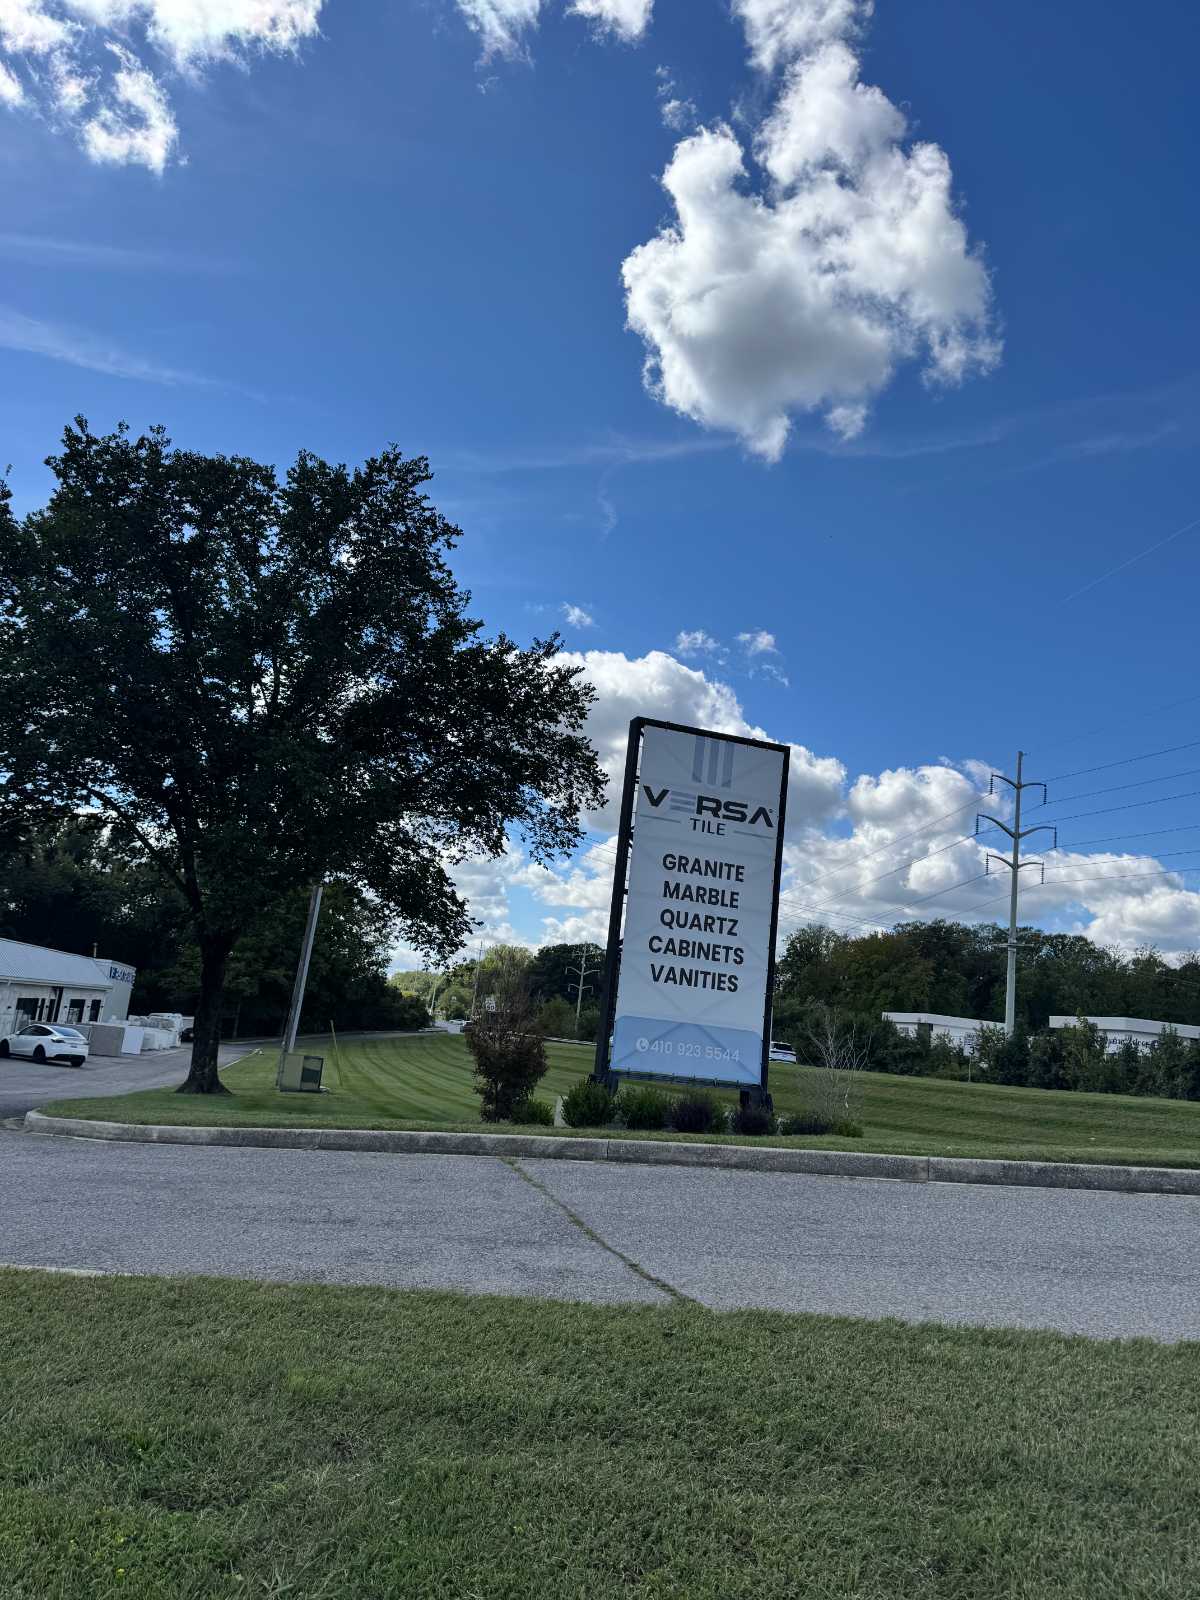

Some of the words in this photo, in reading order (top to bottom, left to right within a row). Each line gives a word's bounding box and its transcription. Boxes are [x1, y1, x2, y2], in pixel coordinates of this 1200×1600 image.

[643, 785, 773, 827] VERSA
[690, 818, 726, 836] TILE
[662, 853, 745, 882] GRANITE
[663, 881, 740, 909] MARBLE
[660, 908, 739, 936] QUARTZ
[648, 935, 744, 965] CABINETS
[650, 963, 739, 993] VANITIES
[650, 1040, 673, 1053] 410
[677, 1042, 701, 1057] 923
